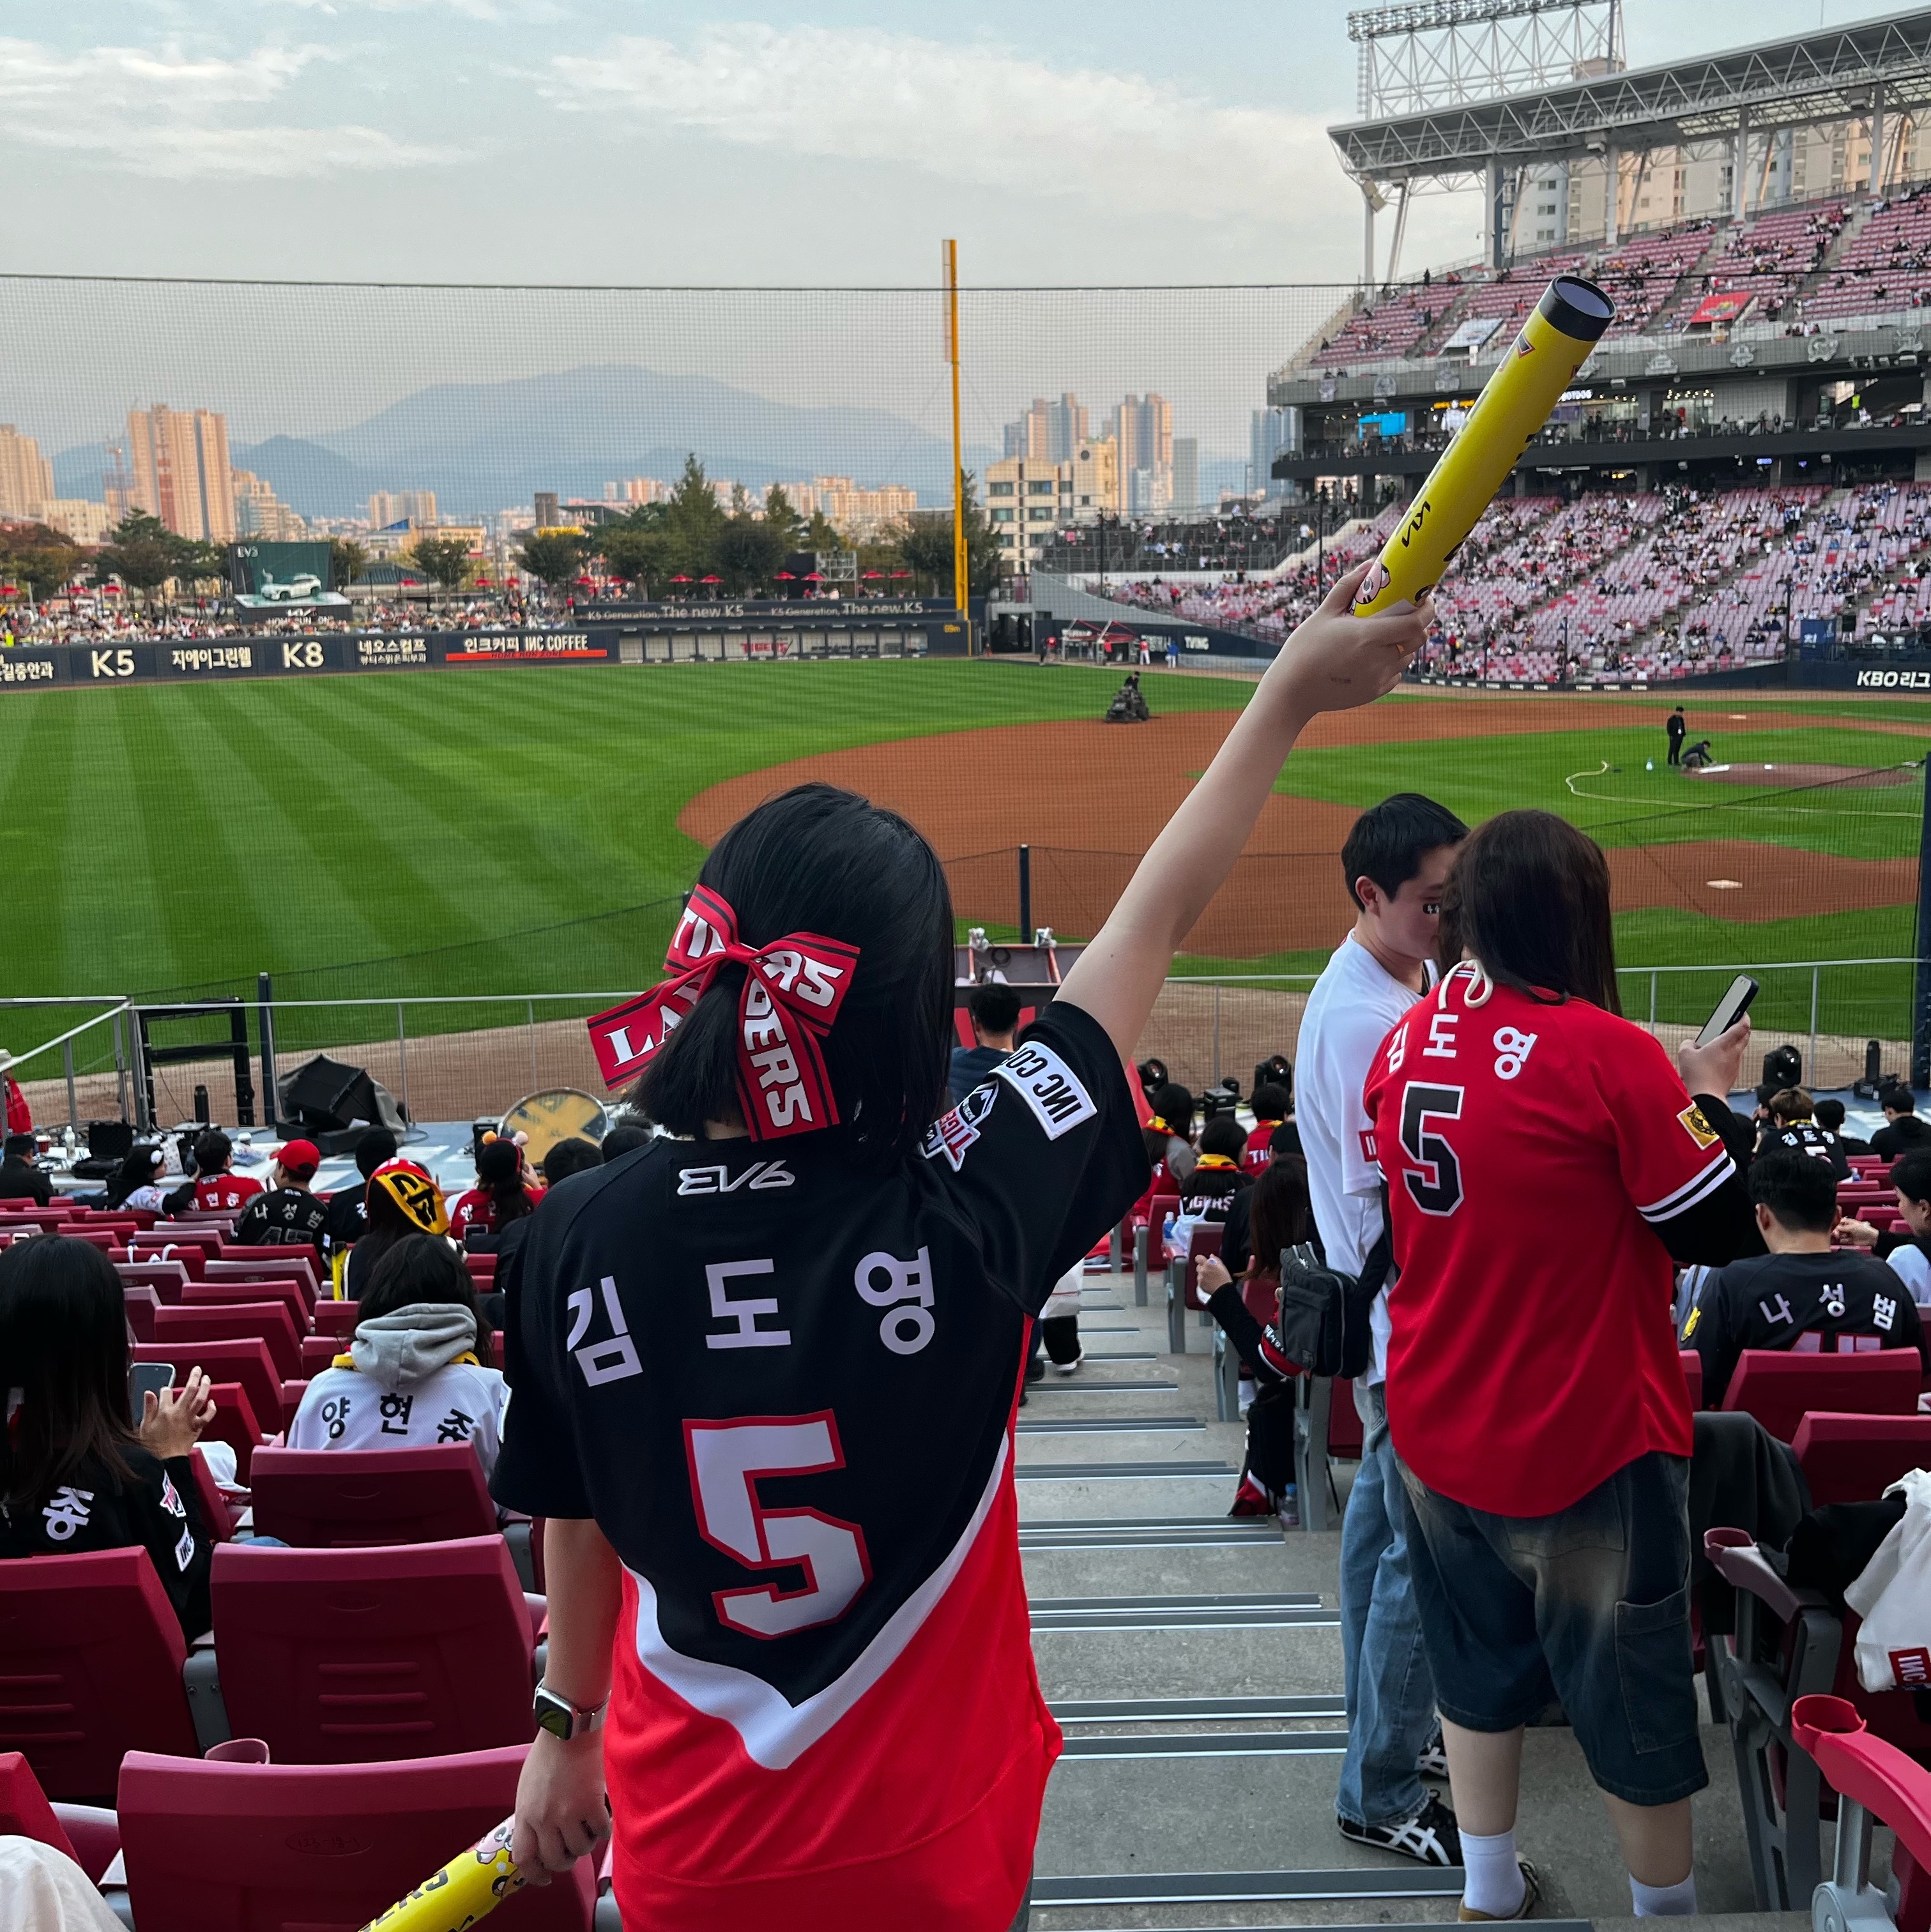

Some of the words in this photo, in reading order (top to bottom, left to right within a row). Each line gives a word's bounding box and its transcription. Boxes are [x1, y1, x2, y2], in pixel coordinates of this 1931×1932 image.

[661, 605, 688, 618] The
[692, 607, 721, 617] new
[725, 604, 744, 617] K5
[843, 603, 868, 615] The
[869, 604, 901, 614] new
[904, 602, 923, 614] K5
[282, 641, 324, 669] K8
[547, 634, 588, 651] COFFEE
[91, 649, 135, 678] K5
[1856, 670, 1898, 688] KBO
[756, 950, 844, 1008] RS
[1398, 1080, 1465, 1217] 5
[677, 1160, 796, 1196] EV6
[682, 1408, 873, 1640] 5
